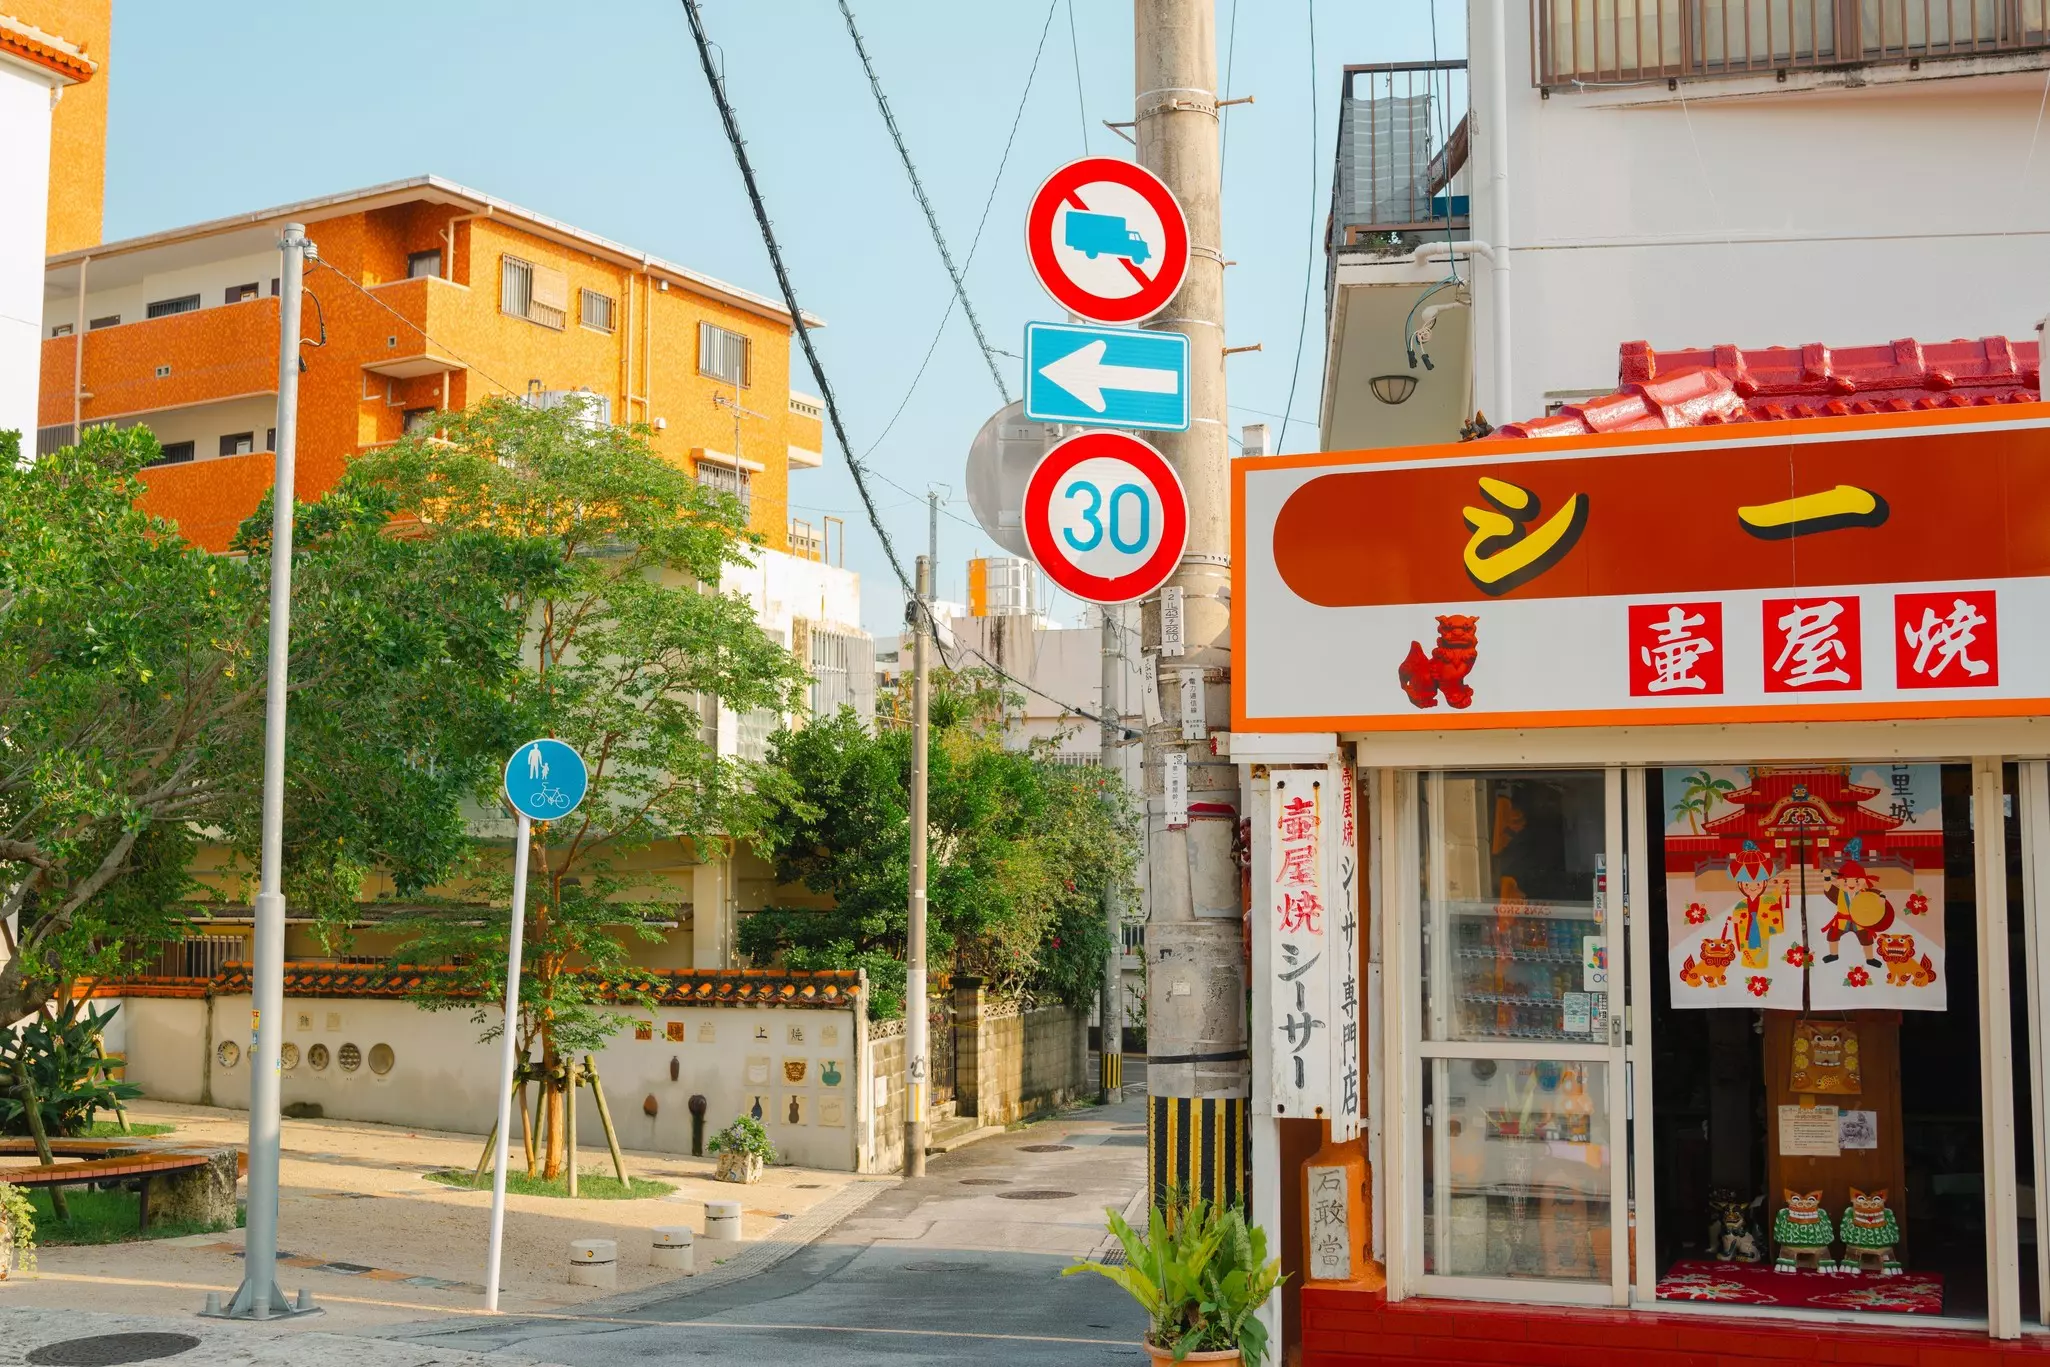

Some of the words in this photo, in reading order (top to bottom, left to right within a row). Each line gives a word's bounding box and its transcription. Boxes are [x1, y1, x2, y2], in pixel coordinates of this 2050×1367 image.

[1063, 480, 1150, 555] 30
[1641, 599, 1989, 693] 壺屋焼
[1889, 764, 1917, 824] 里城
[1312, 1169, 1345, 1267] 石敢當
